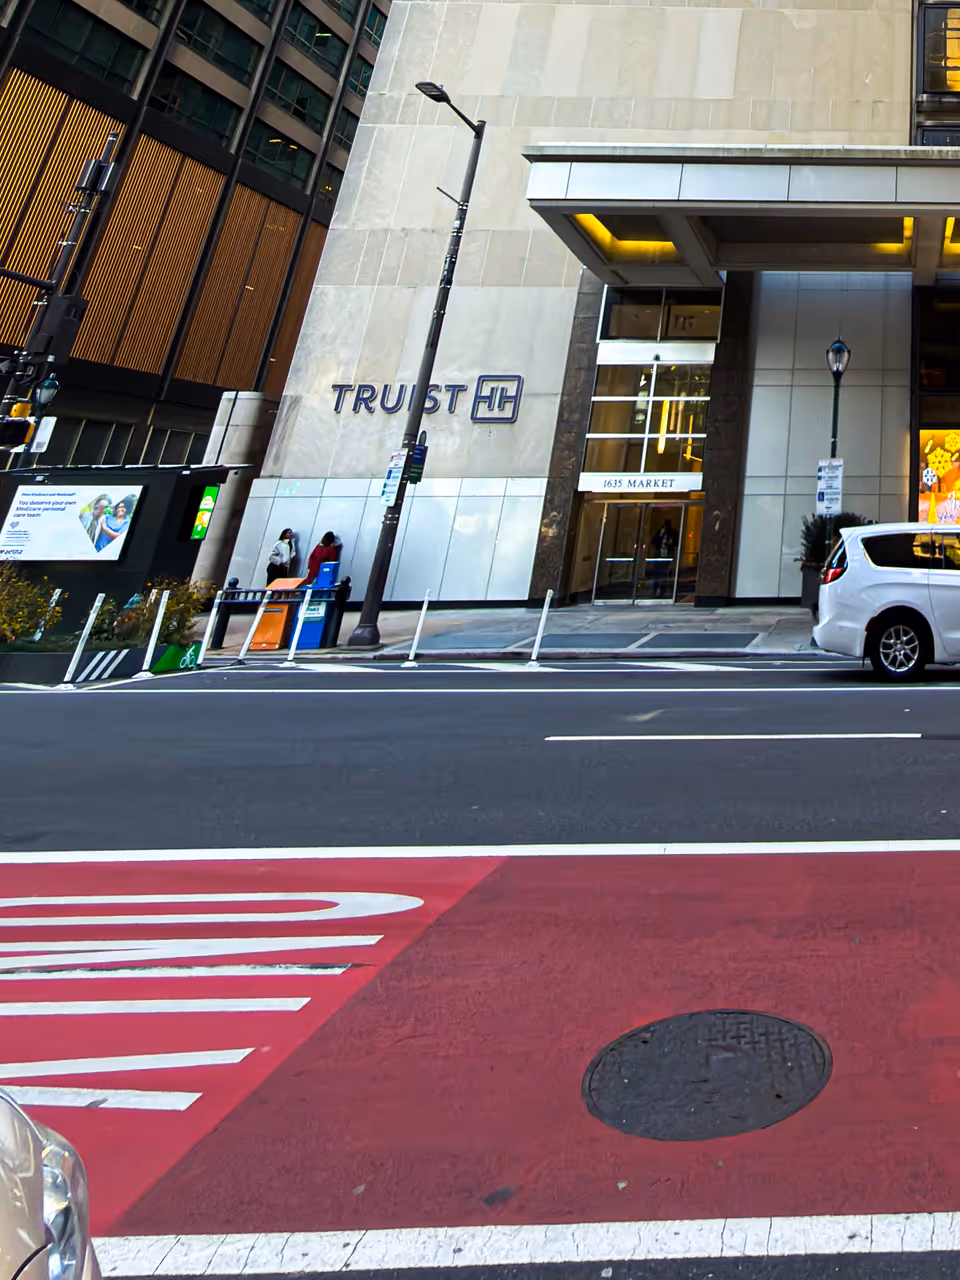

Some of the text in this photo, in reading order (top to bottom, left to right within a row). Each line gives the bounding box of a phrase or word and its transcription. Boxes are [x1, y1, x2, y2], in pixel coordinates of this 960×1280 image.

[331, 384, 468, 414] TRUIST
[603, 478, 675, 489] 1635 MARKET
